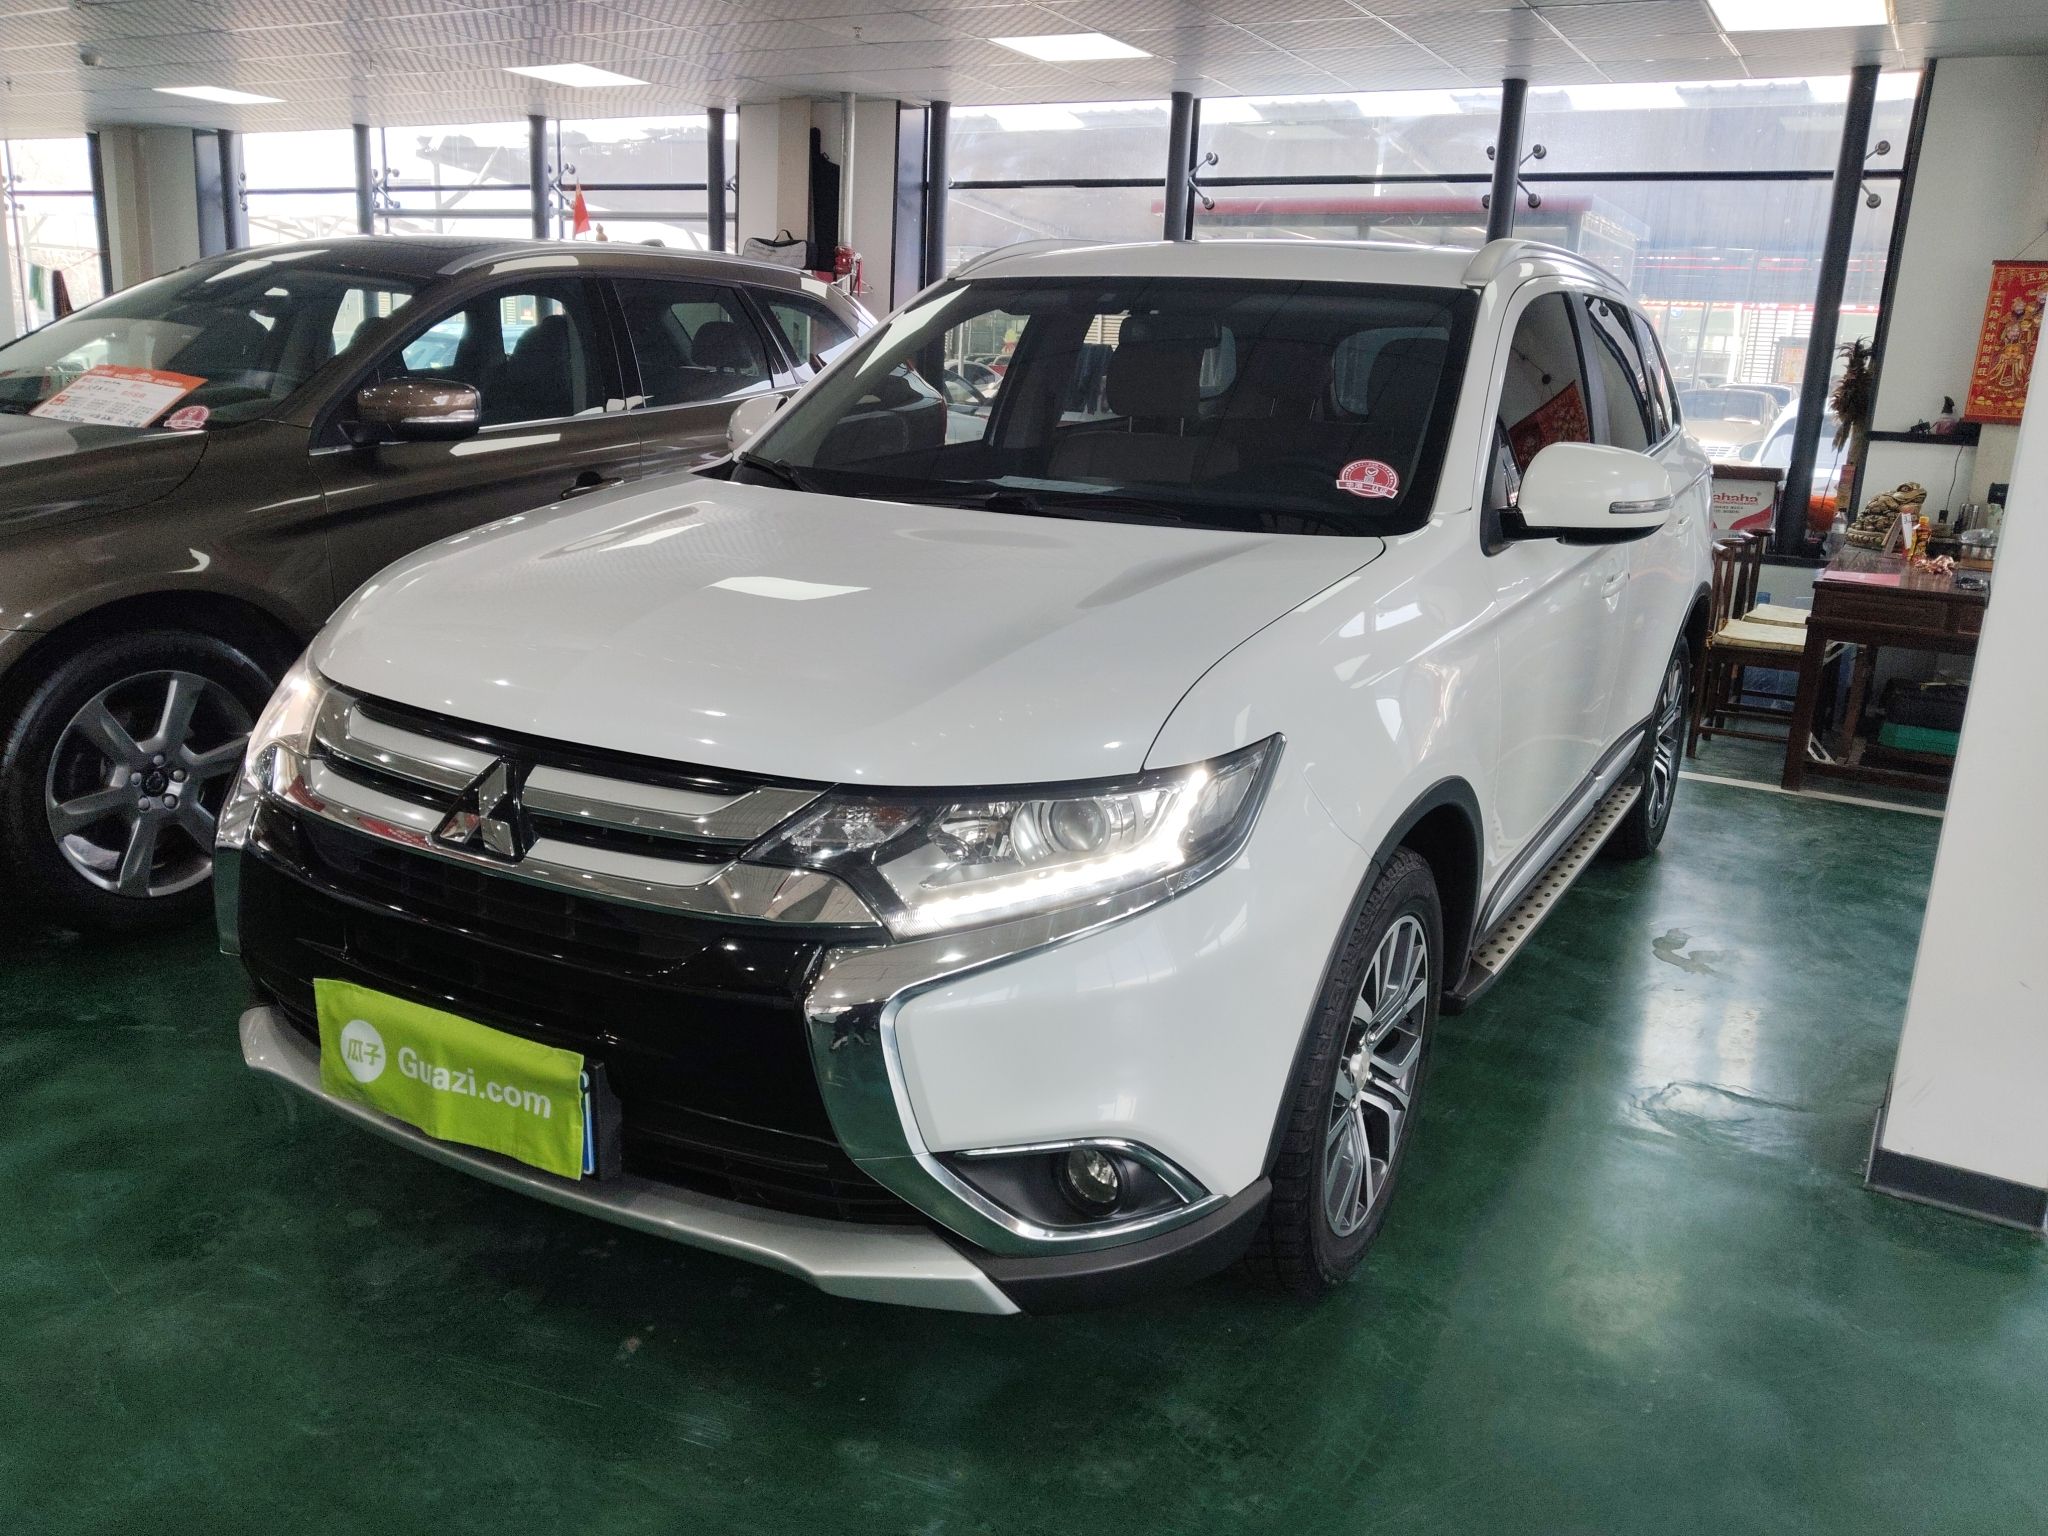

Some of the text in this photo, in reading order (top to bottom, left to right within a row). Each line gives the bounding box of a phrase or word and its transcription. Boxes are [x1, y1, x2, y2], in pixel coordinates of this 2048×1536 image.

[1713, 492, 1758, 503] ahaha
[347, 1038, 382, 1066] 瓜子
[398, 1047, 551, 1119] Guazi.com
